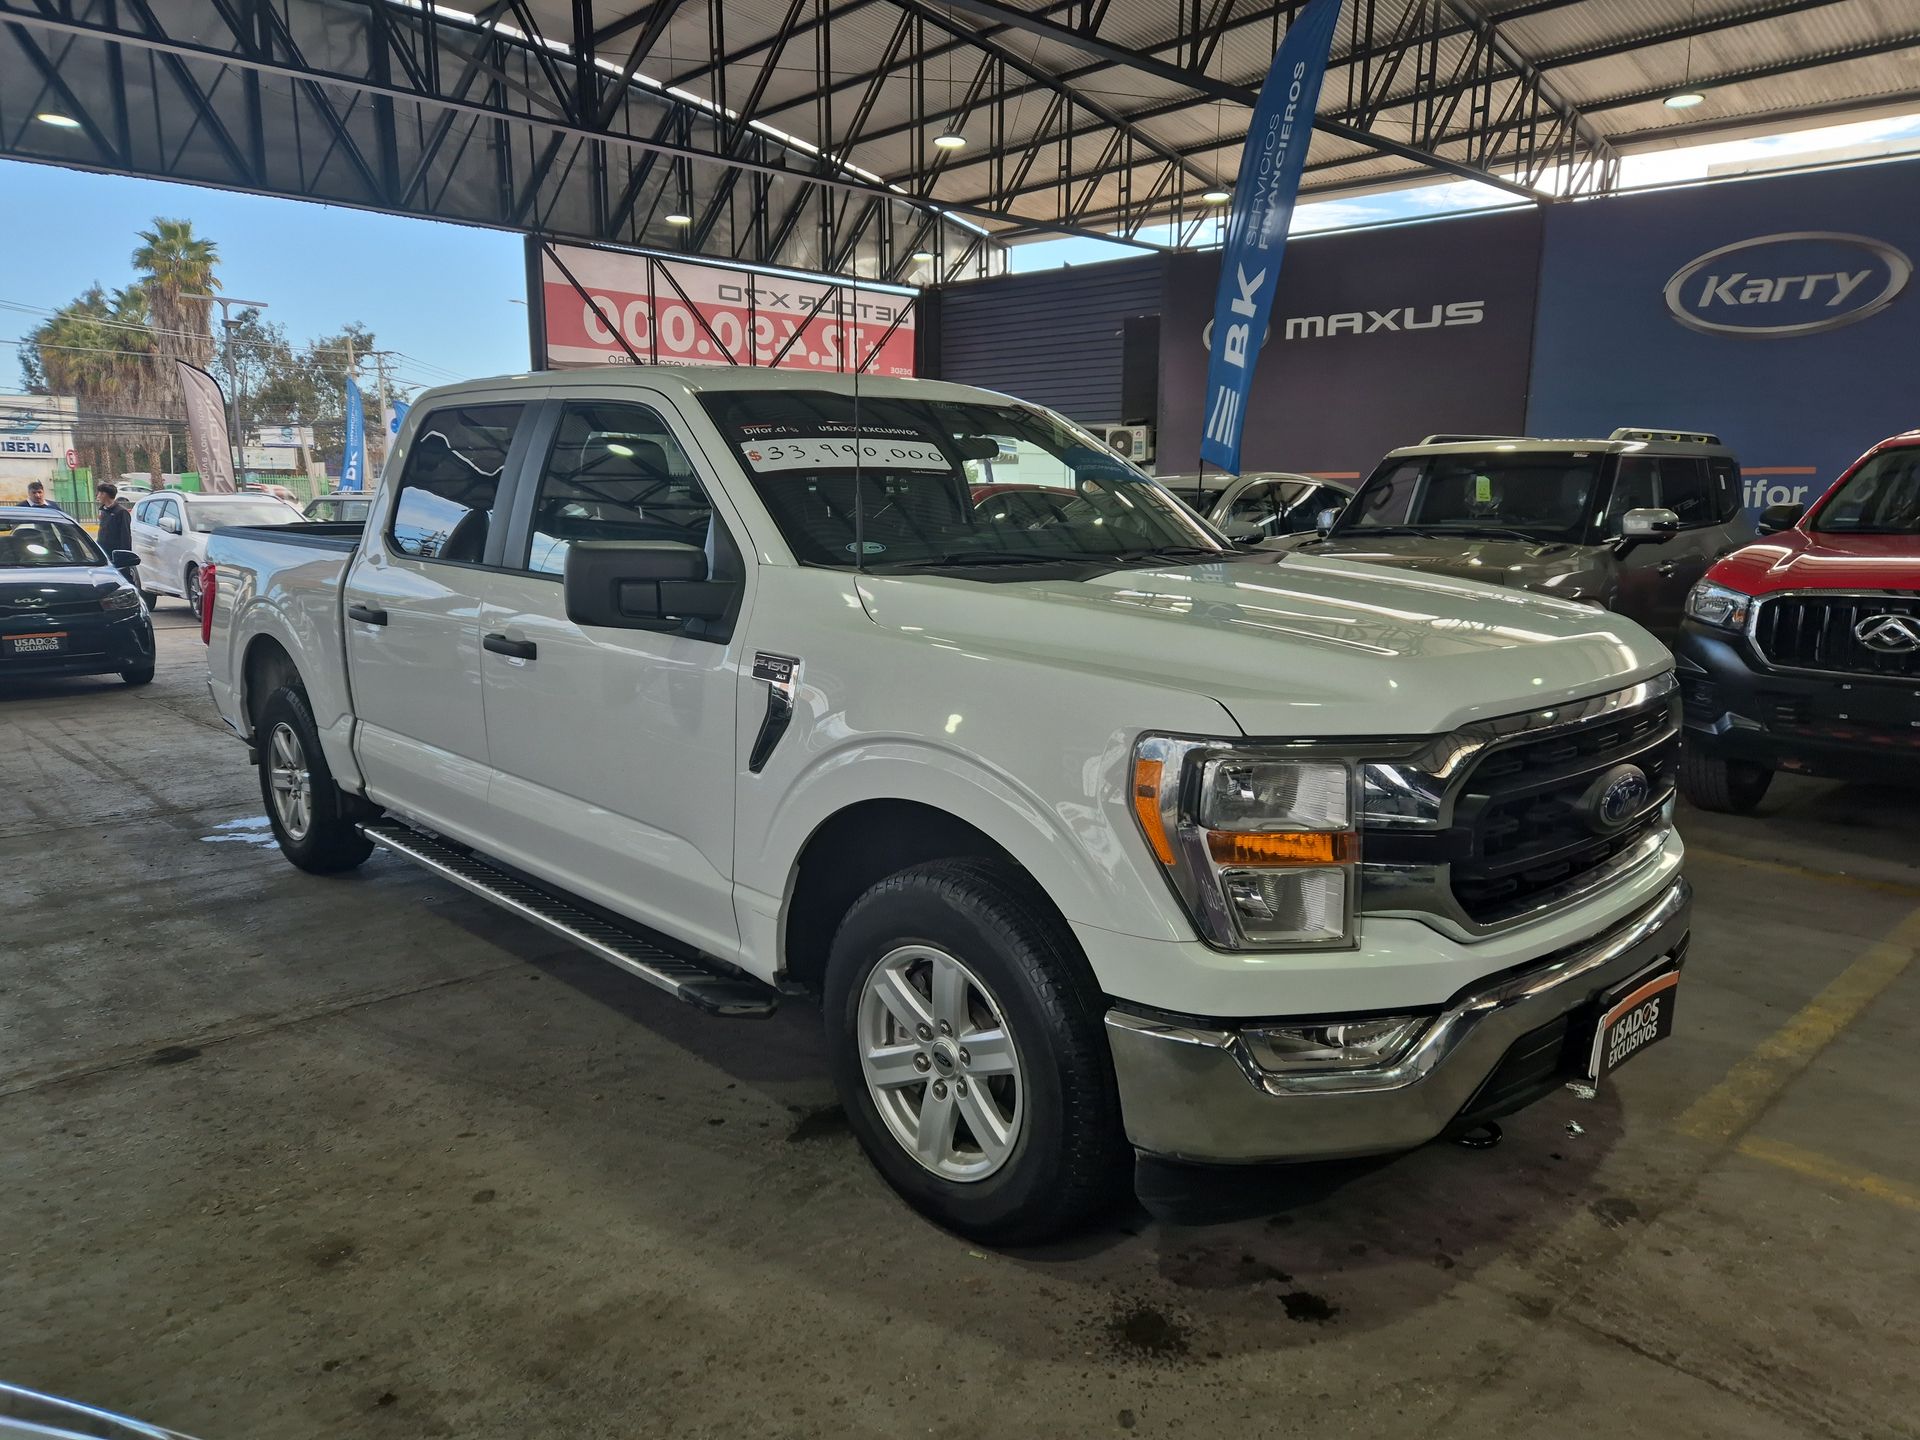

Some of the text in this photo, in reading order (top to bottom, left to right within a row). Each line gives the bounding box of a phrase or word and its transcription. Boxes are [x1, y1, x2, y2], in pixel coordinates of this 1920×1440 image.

[1258, 61, 1305, 250] FINANCIEROS
[1246, 113, 1280, 247] SERVICIOS
[1698, 269, 1873, 308] Karry
[1224, 262, 1267, 369] BK
[1286, 300, 1485, 340] MAXUS
[1, 441, 52, 453] IBERIA
[863, 426, 919, 436] EXCLUSIVOS
[1743, 479, 1809, 508] ifor
[14, 637, 58, 647] USADOS
[754, 658, 790, 673] F-150
[1611, 998, 1660, 1049] USADOS
[1608, 1021, 1658, 1069] EXCLUSIVOS
